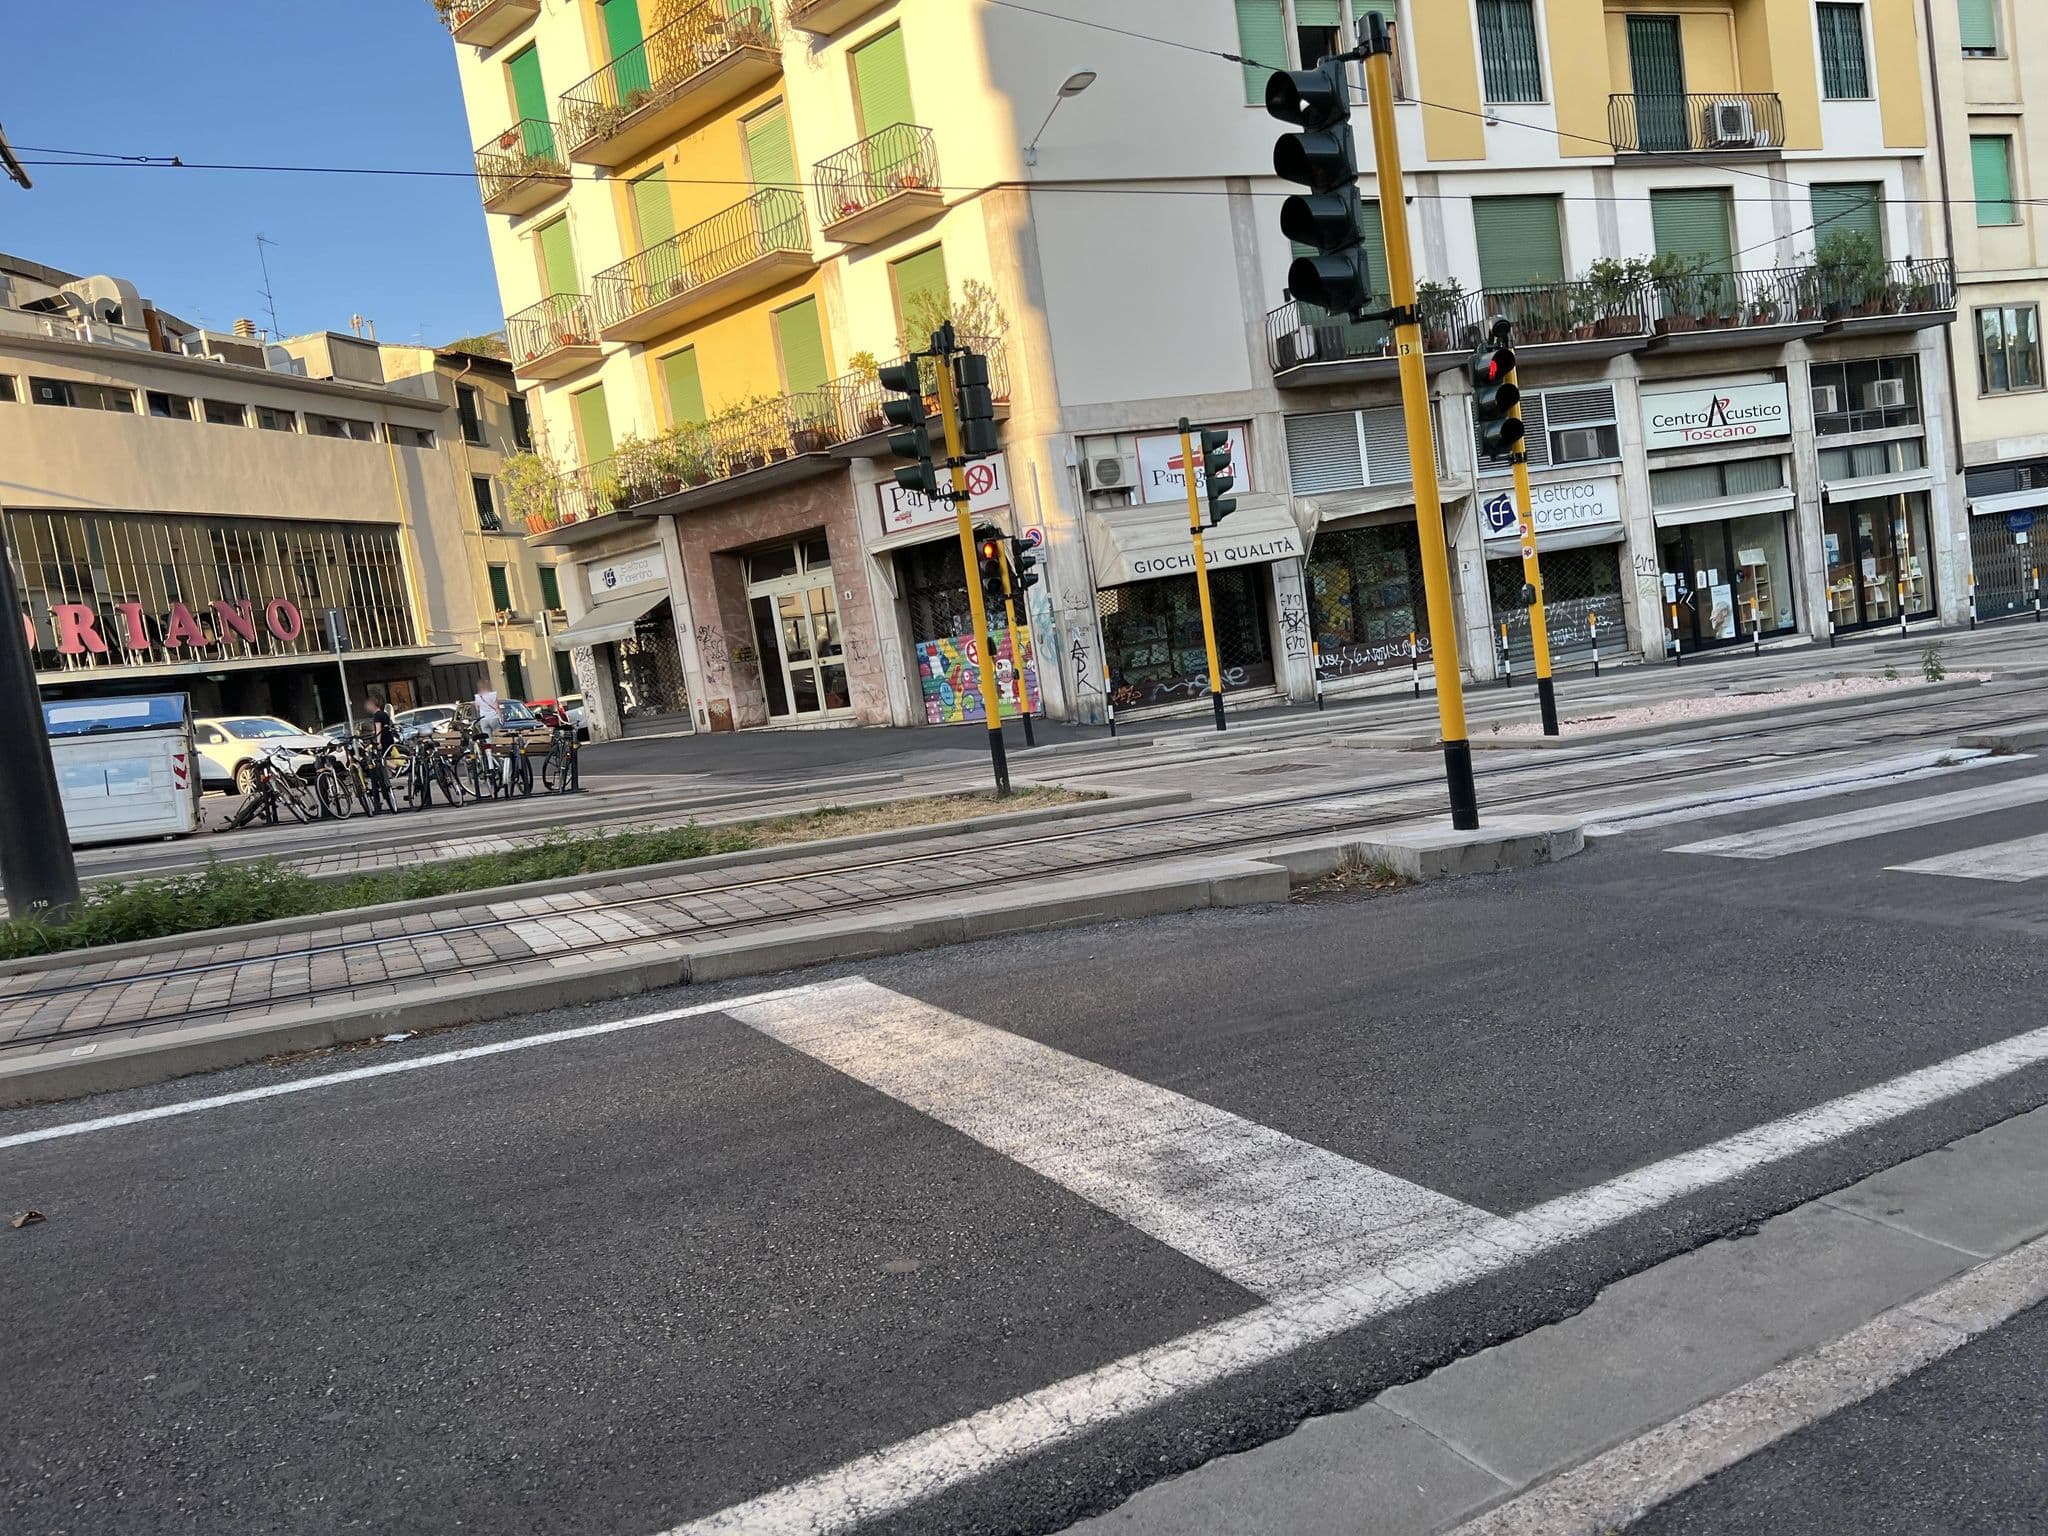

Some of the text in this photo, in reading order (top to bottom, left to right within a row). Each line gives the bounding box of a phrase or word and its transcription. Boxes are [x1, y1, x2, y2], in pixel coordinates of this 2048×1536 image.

[1681, 424, 1757, 441] Toscano
[1534, 502, 1604, 524] iorentina
[1134, 552, 1196, 574] GIOCHI
[1224, 537, 1295, 561] QUALITÀ
